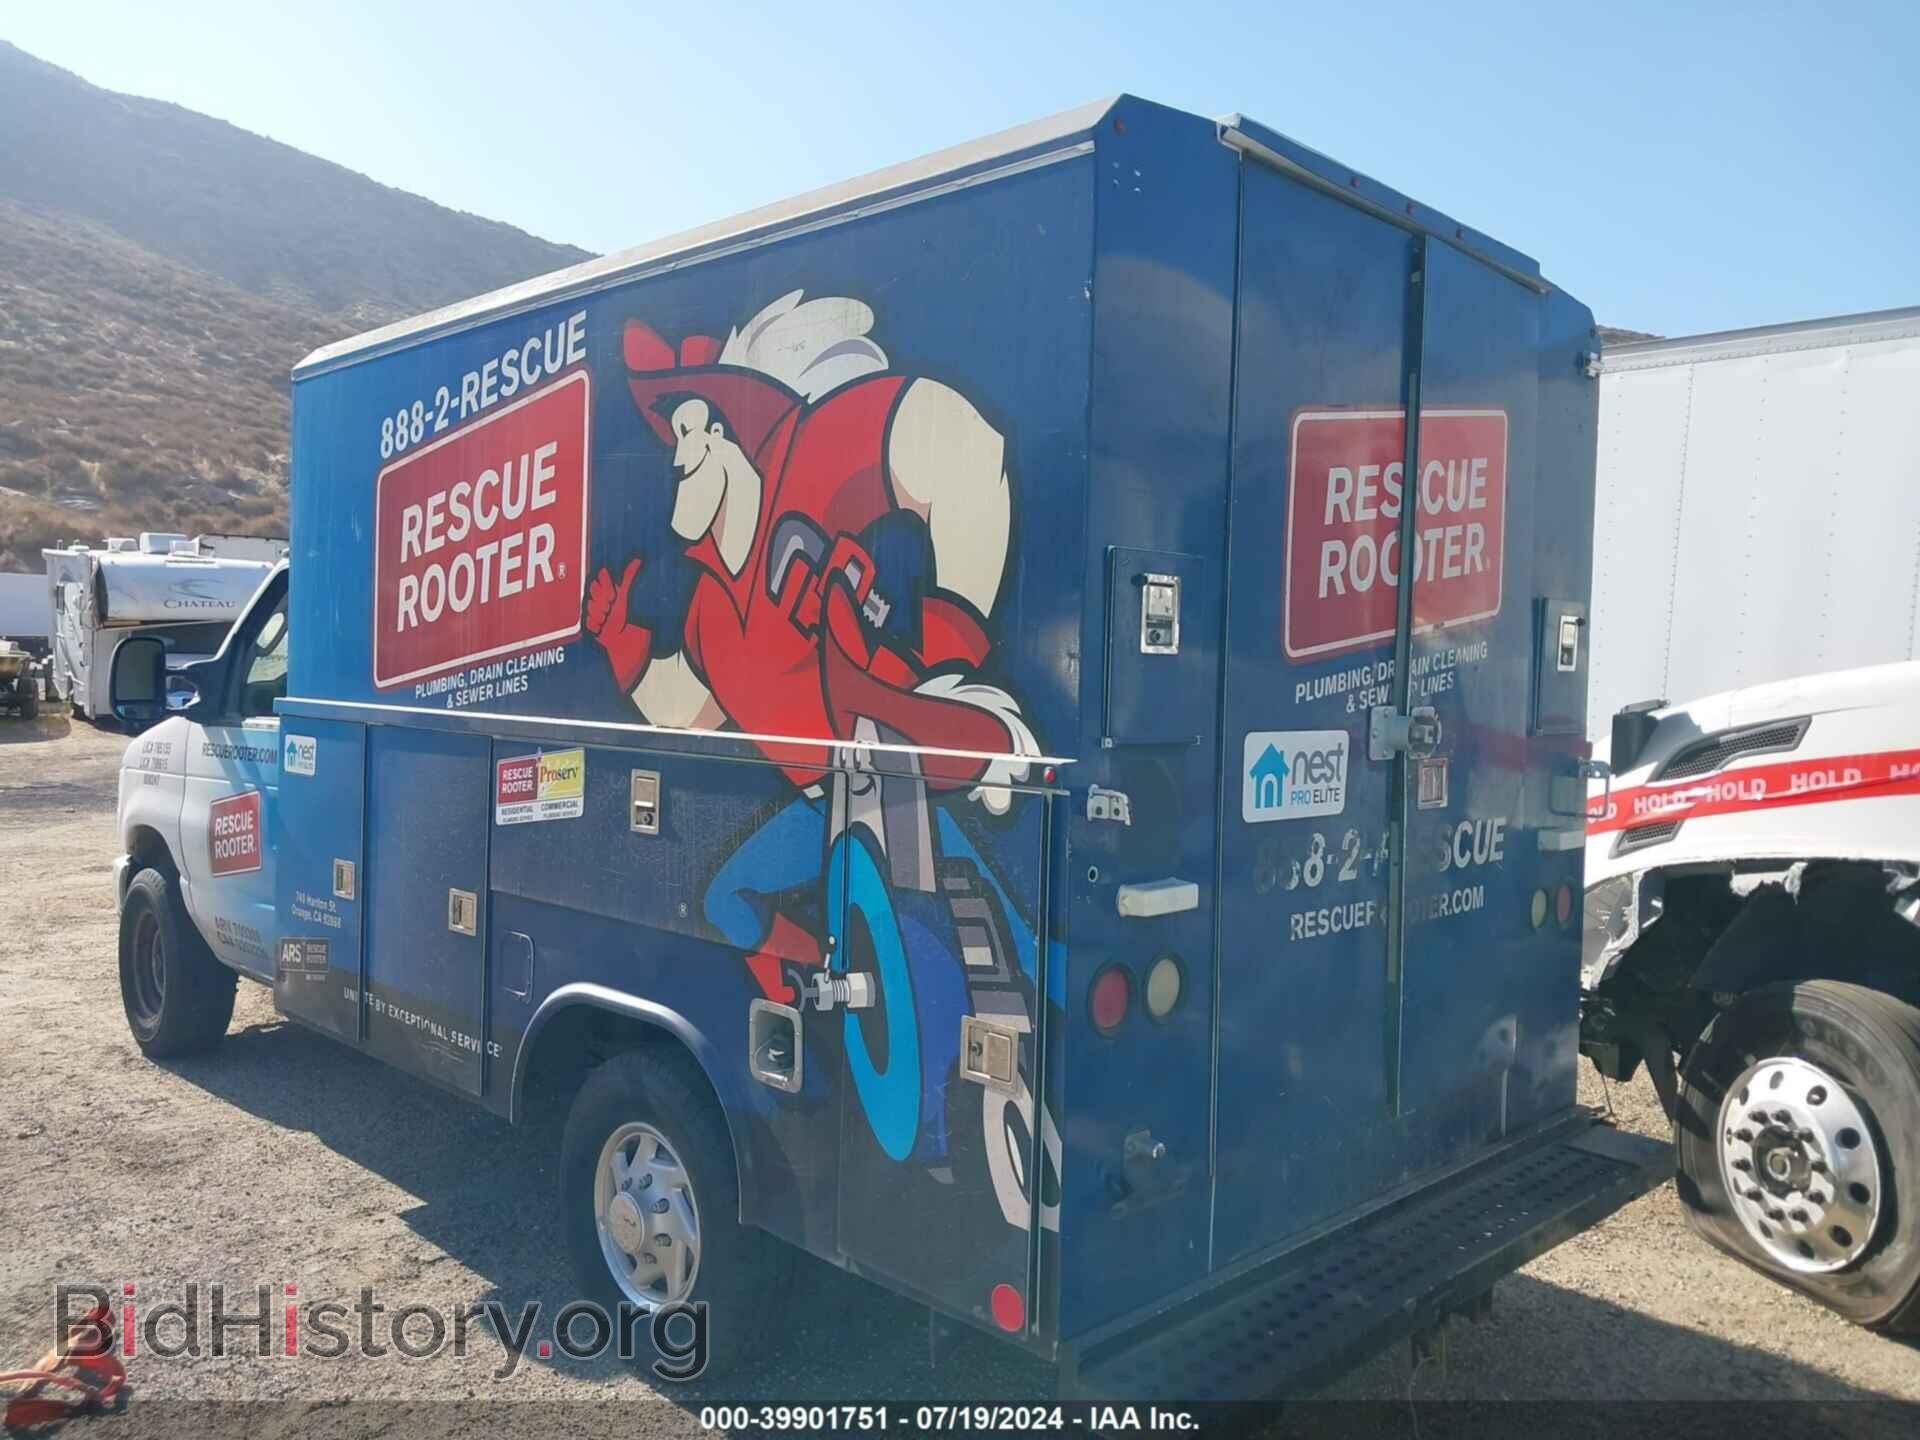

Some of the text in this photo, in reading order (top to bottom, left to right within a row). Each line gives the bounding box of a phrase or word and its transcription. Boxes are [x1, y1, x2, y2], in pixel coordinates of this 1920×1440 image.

[380, 310, 586, 459] 888-2-RESCUE
[401, 441, 557, 563] RESCUE
[1323, 457, 1488, 525] RESCUE
[397, 523, 555, 632] ROOTER
[163, 600, 236, 609] CHATEAU
[415, 646, 565, 699] PLUMBING, DRAIN CLEANING
[1295, 665, 1375, 704] PLUMBING,
[1432, 641, 1488, 671] CLEANING
[446, 675, 528, 709] & SEWER LINES
[1346, 694, 1356, 713] &
[1420, 671, 1454, 697] LINES
[299, 743, 315, 760] nest
[1292, 742, 1344, 785] nest
[502, 780, 533, 794] ROOTER
[503, 766, 534, 780] RESCUE
[1790, 767, 1863, 793] HOLD
[1290, 787, 1341, 806] PRO ELITE
[1706, 778, 1767, 803] HOLD
[215, 810, 254, 836] RESCUE
[1587, 803, 1617, 823] OLD
[282, 943, 301, 963] ARS
[375, 999, 386, 1014] BY
[388, 1004, 448, 1041] EXCEPTIONAL
[451, 1030, 500, 1058] SERVICE
